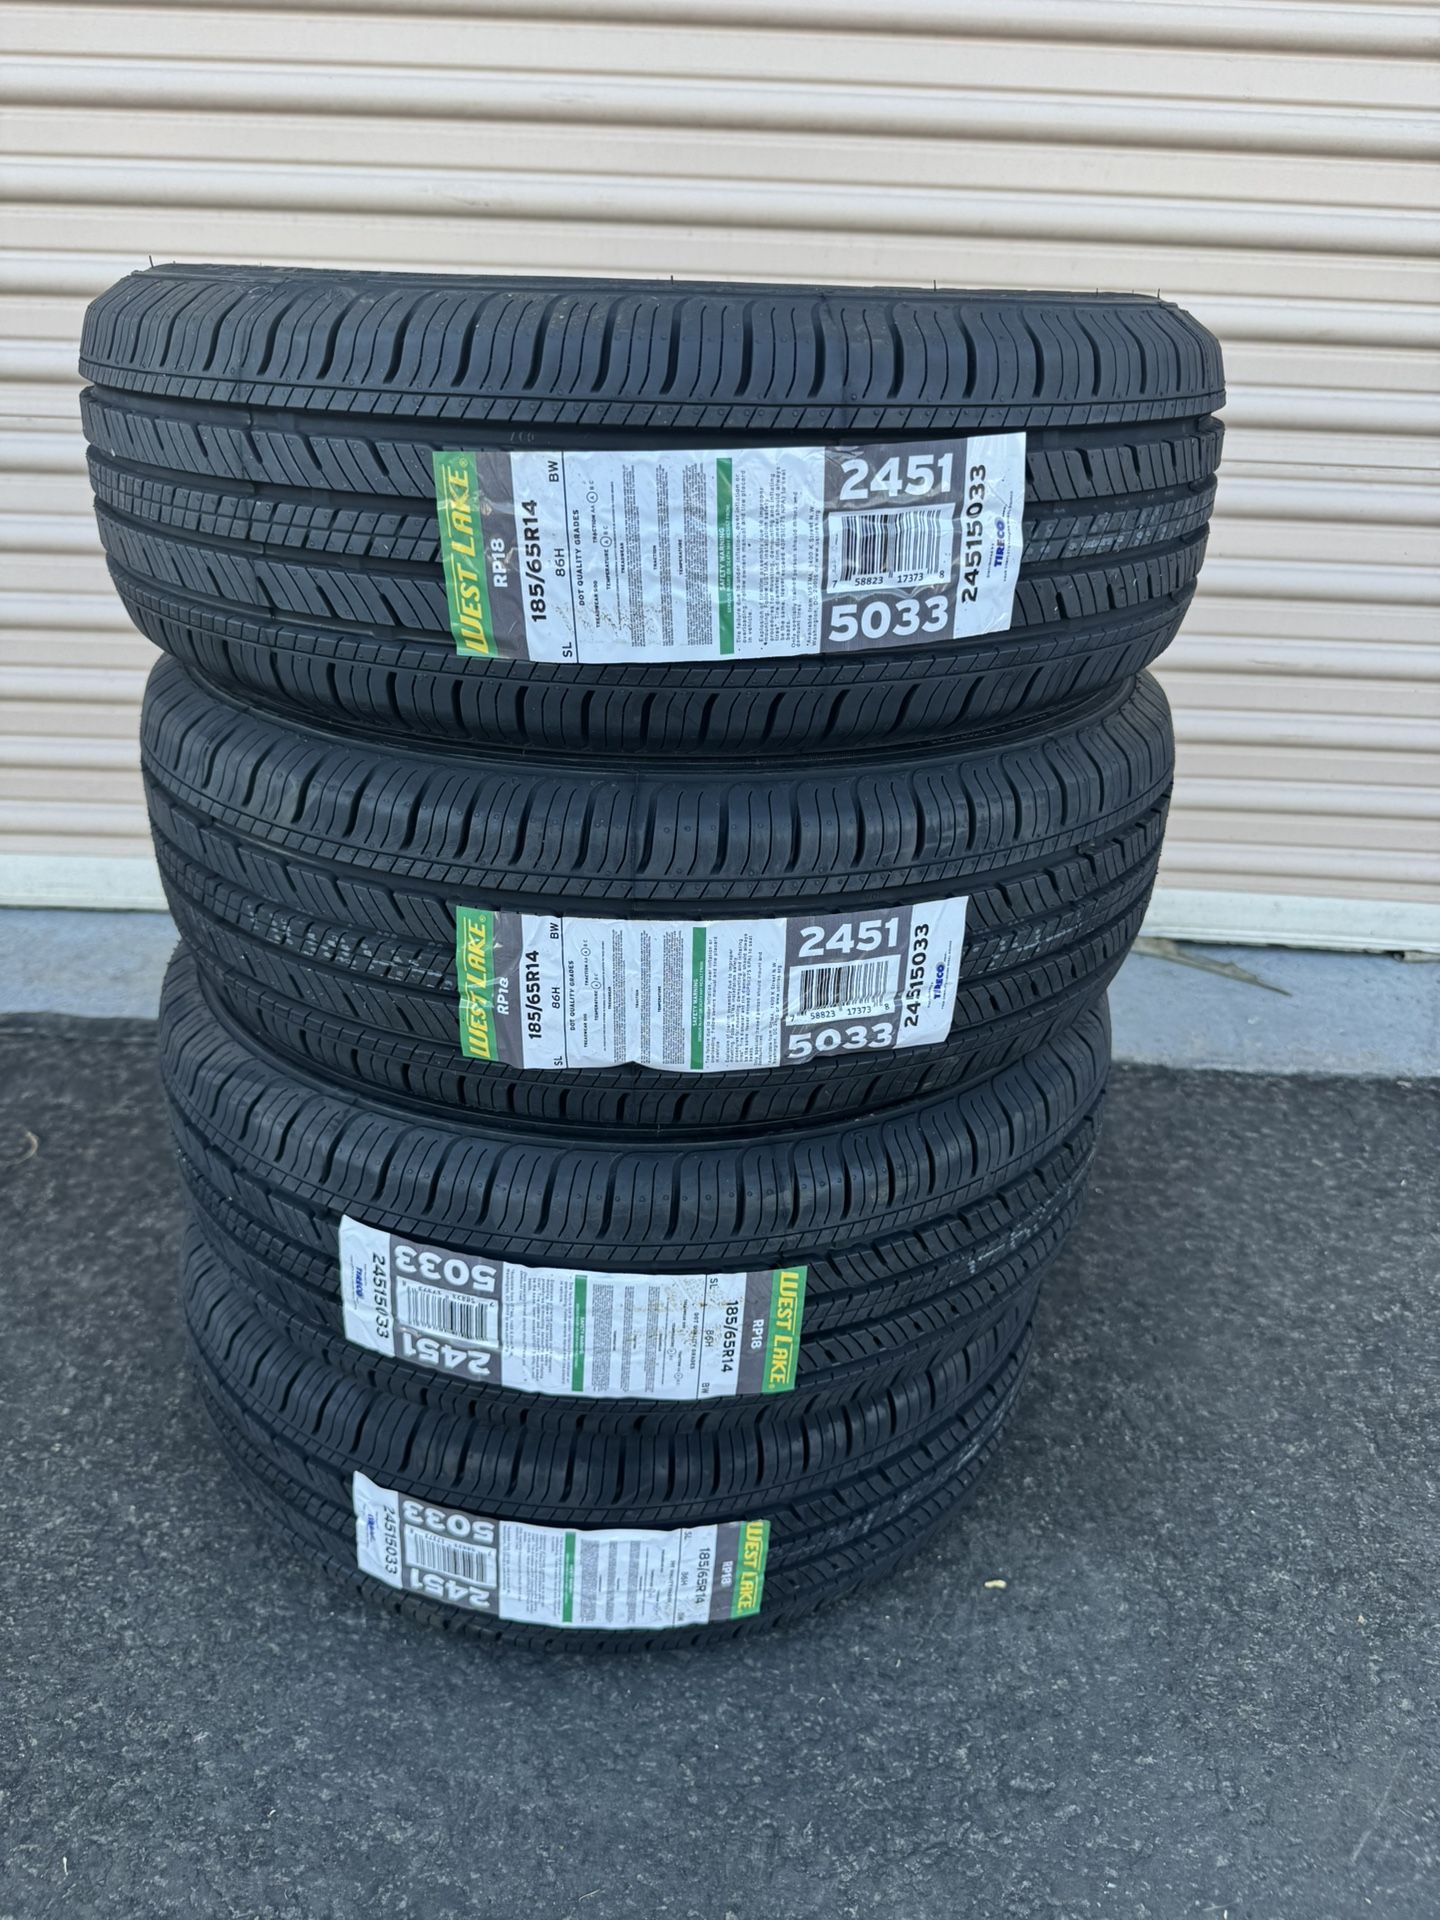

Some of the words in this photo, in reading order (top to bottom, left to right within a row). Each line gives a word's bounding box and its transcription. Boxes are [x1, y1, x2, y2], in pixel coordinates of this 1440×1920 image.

[548, 460, 560, 483] BW
[839, 453, 954, 501] 2451
[442, 464, 475, 557] LAKE
[572, 509, 581, 545] GRADES
[962, 464, 986, 604] 24515033
[994, 518, 1006, 568] TIRECO
[490, 537, 508, 588] RP18
[523, 499, 547, 623] 185/65R14
[555, 547, 567, 577] 86H
[574, 548, 584, 587] QUALITY
[603, 549, 611, 590] TEMPERATURE
[831, 580, 838, 588] 7
[854, 576, 885, 587] 58823
[896, 572, 925, 584] 17373
[938, 570, 945, 579] 8
[450, 554, 489, 654] WEST
[577, 588, 585, 606] DOT
[828, 595, 949, 643] 5033
[562, 641, 573, 657] SL
[463, 917, 487, 989] LAKE
[549, 922, 560, 940] BW
[798, 917, 899, 958] 2451
[525, 950, 543, 1041] 185/65R14
[551, 985, 561, 1010] 86H
[904, 923, 929, 1028] 24515033
[933, 963, 945, 1000] TIRECO
[466, 986, 491, 1059] WEST
[810, 1009, 837, 1020] 58823
[847, 1005, 873, 1015] 17373
[884, 1002, 891, 1011] 8
[554, 1056, 563, 1067] SL
[788, 1022, 894, 1059] 5033
[394, 1245, 497, 1292] 5033
[709, 1278, 718, 1290] SL
[372, 1252, 389, 1339] 24515033
[776, 1271, 799, 1334] WEST
[402, 1332, 491, 1376] 2451
[721, 1300, 739, 1373] 185/65R14
[751, 1319, 764, 1349] RP18
[770, 1335, 793, 1384] LAKE
[384, 1505, 398, 1575] 24515033
[402, 1500, 495, 1545] 5033
[743, 1522, 763, 1570] WEST
[410, 1568, 490, 1609] 2451
[695, 1548, 711, 1604] 185/65R14
[721, 1560, 733, 1587] RP18
